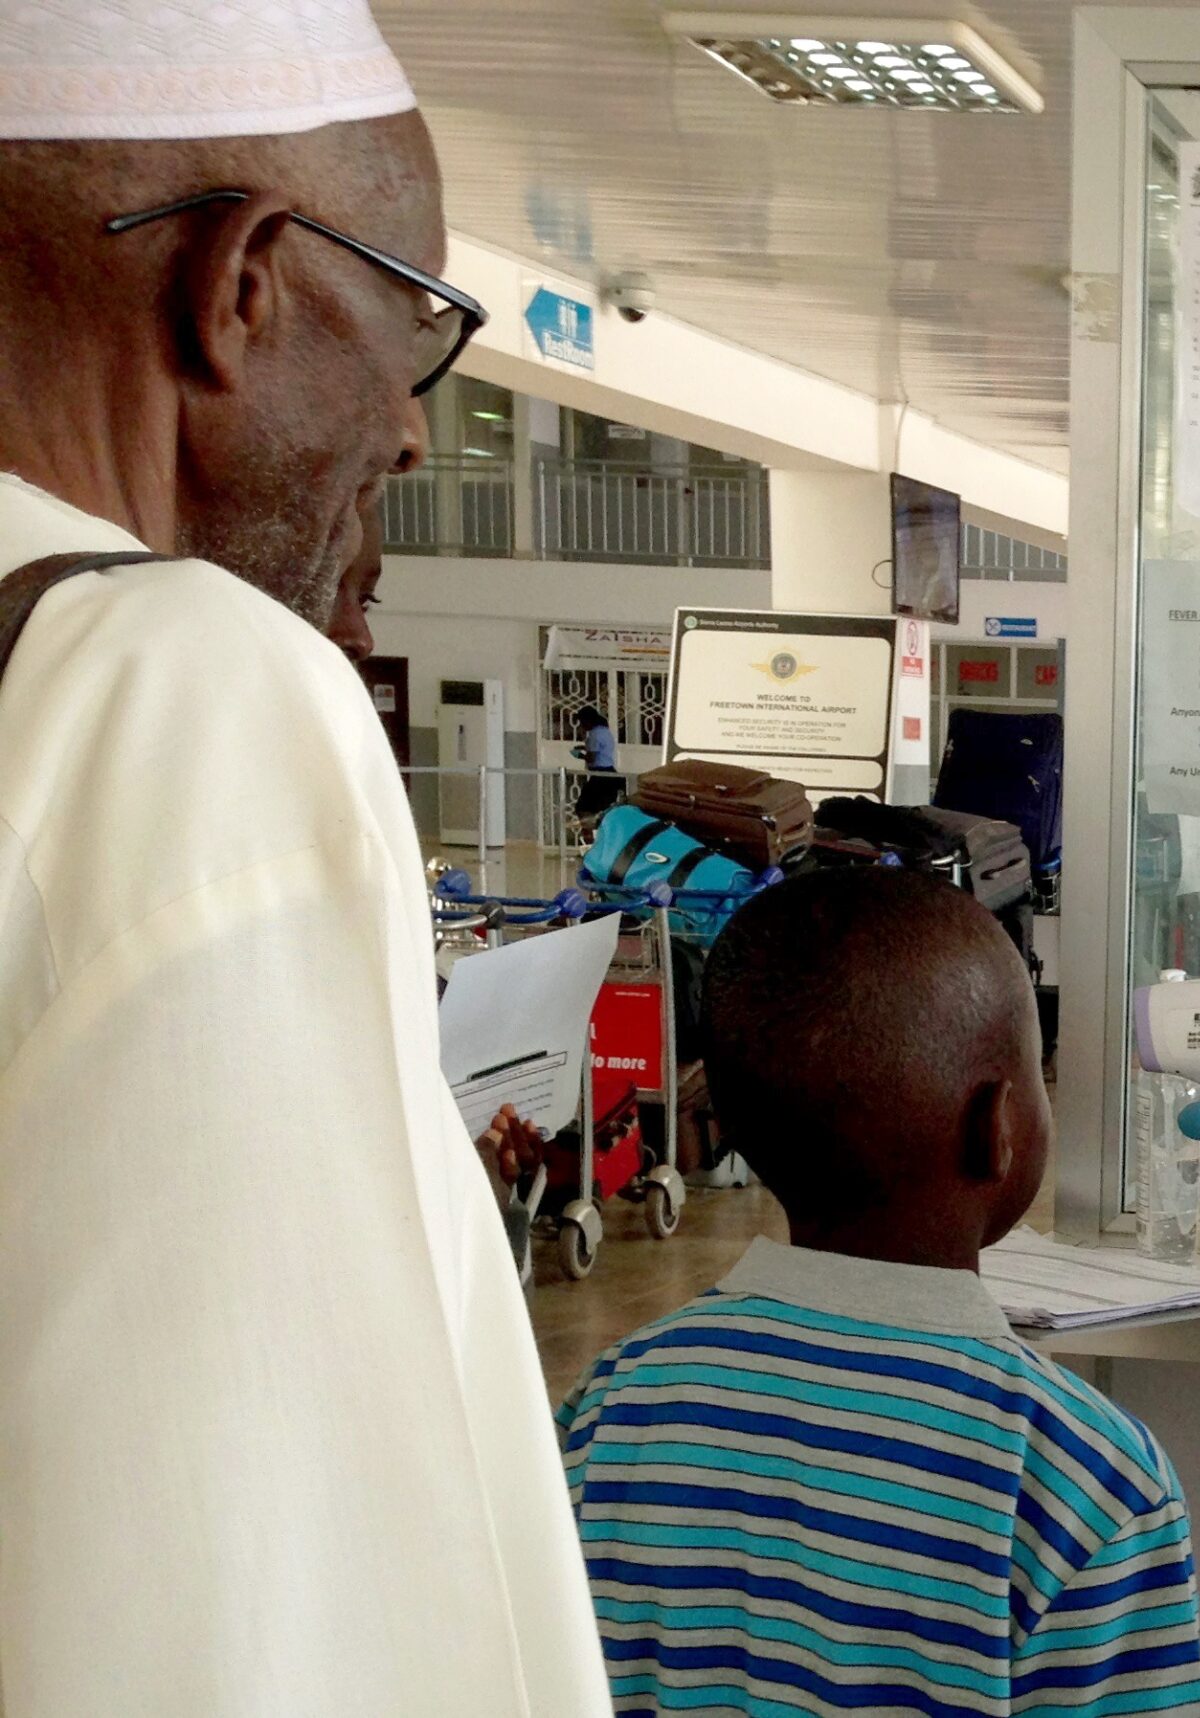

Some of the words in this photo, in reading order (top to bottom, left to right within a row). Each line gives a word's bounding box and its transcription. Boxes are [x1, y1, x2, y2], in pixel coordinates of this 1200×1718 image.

[1169, 610, 1197, 619] FEVER
[757, 694, 797, 702] WELCOME
[710, 701, 754, 711] FREETOWN
[755, 703, 819, 714] INTERNATIONAL
[821, 706, 857, 715] AIRPORT
[1170, 766, 1187, 777] Any
[607, 1055, 647, 1071] more
